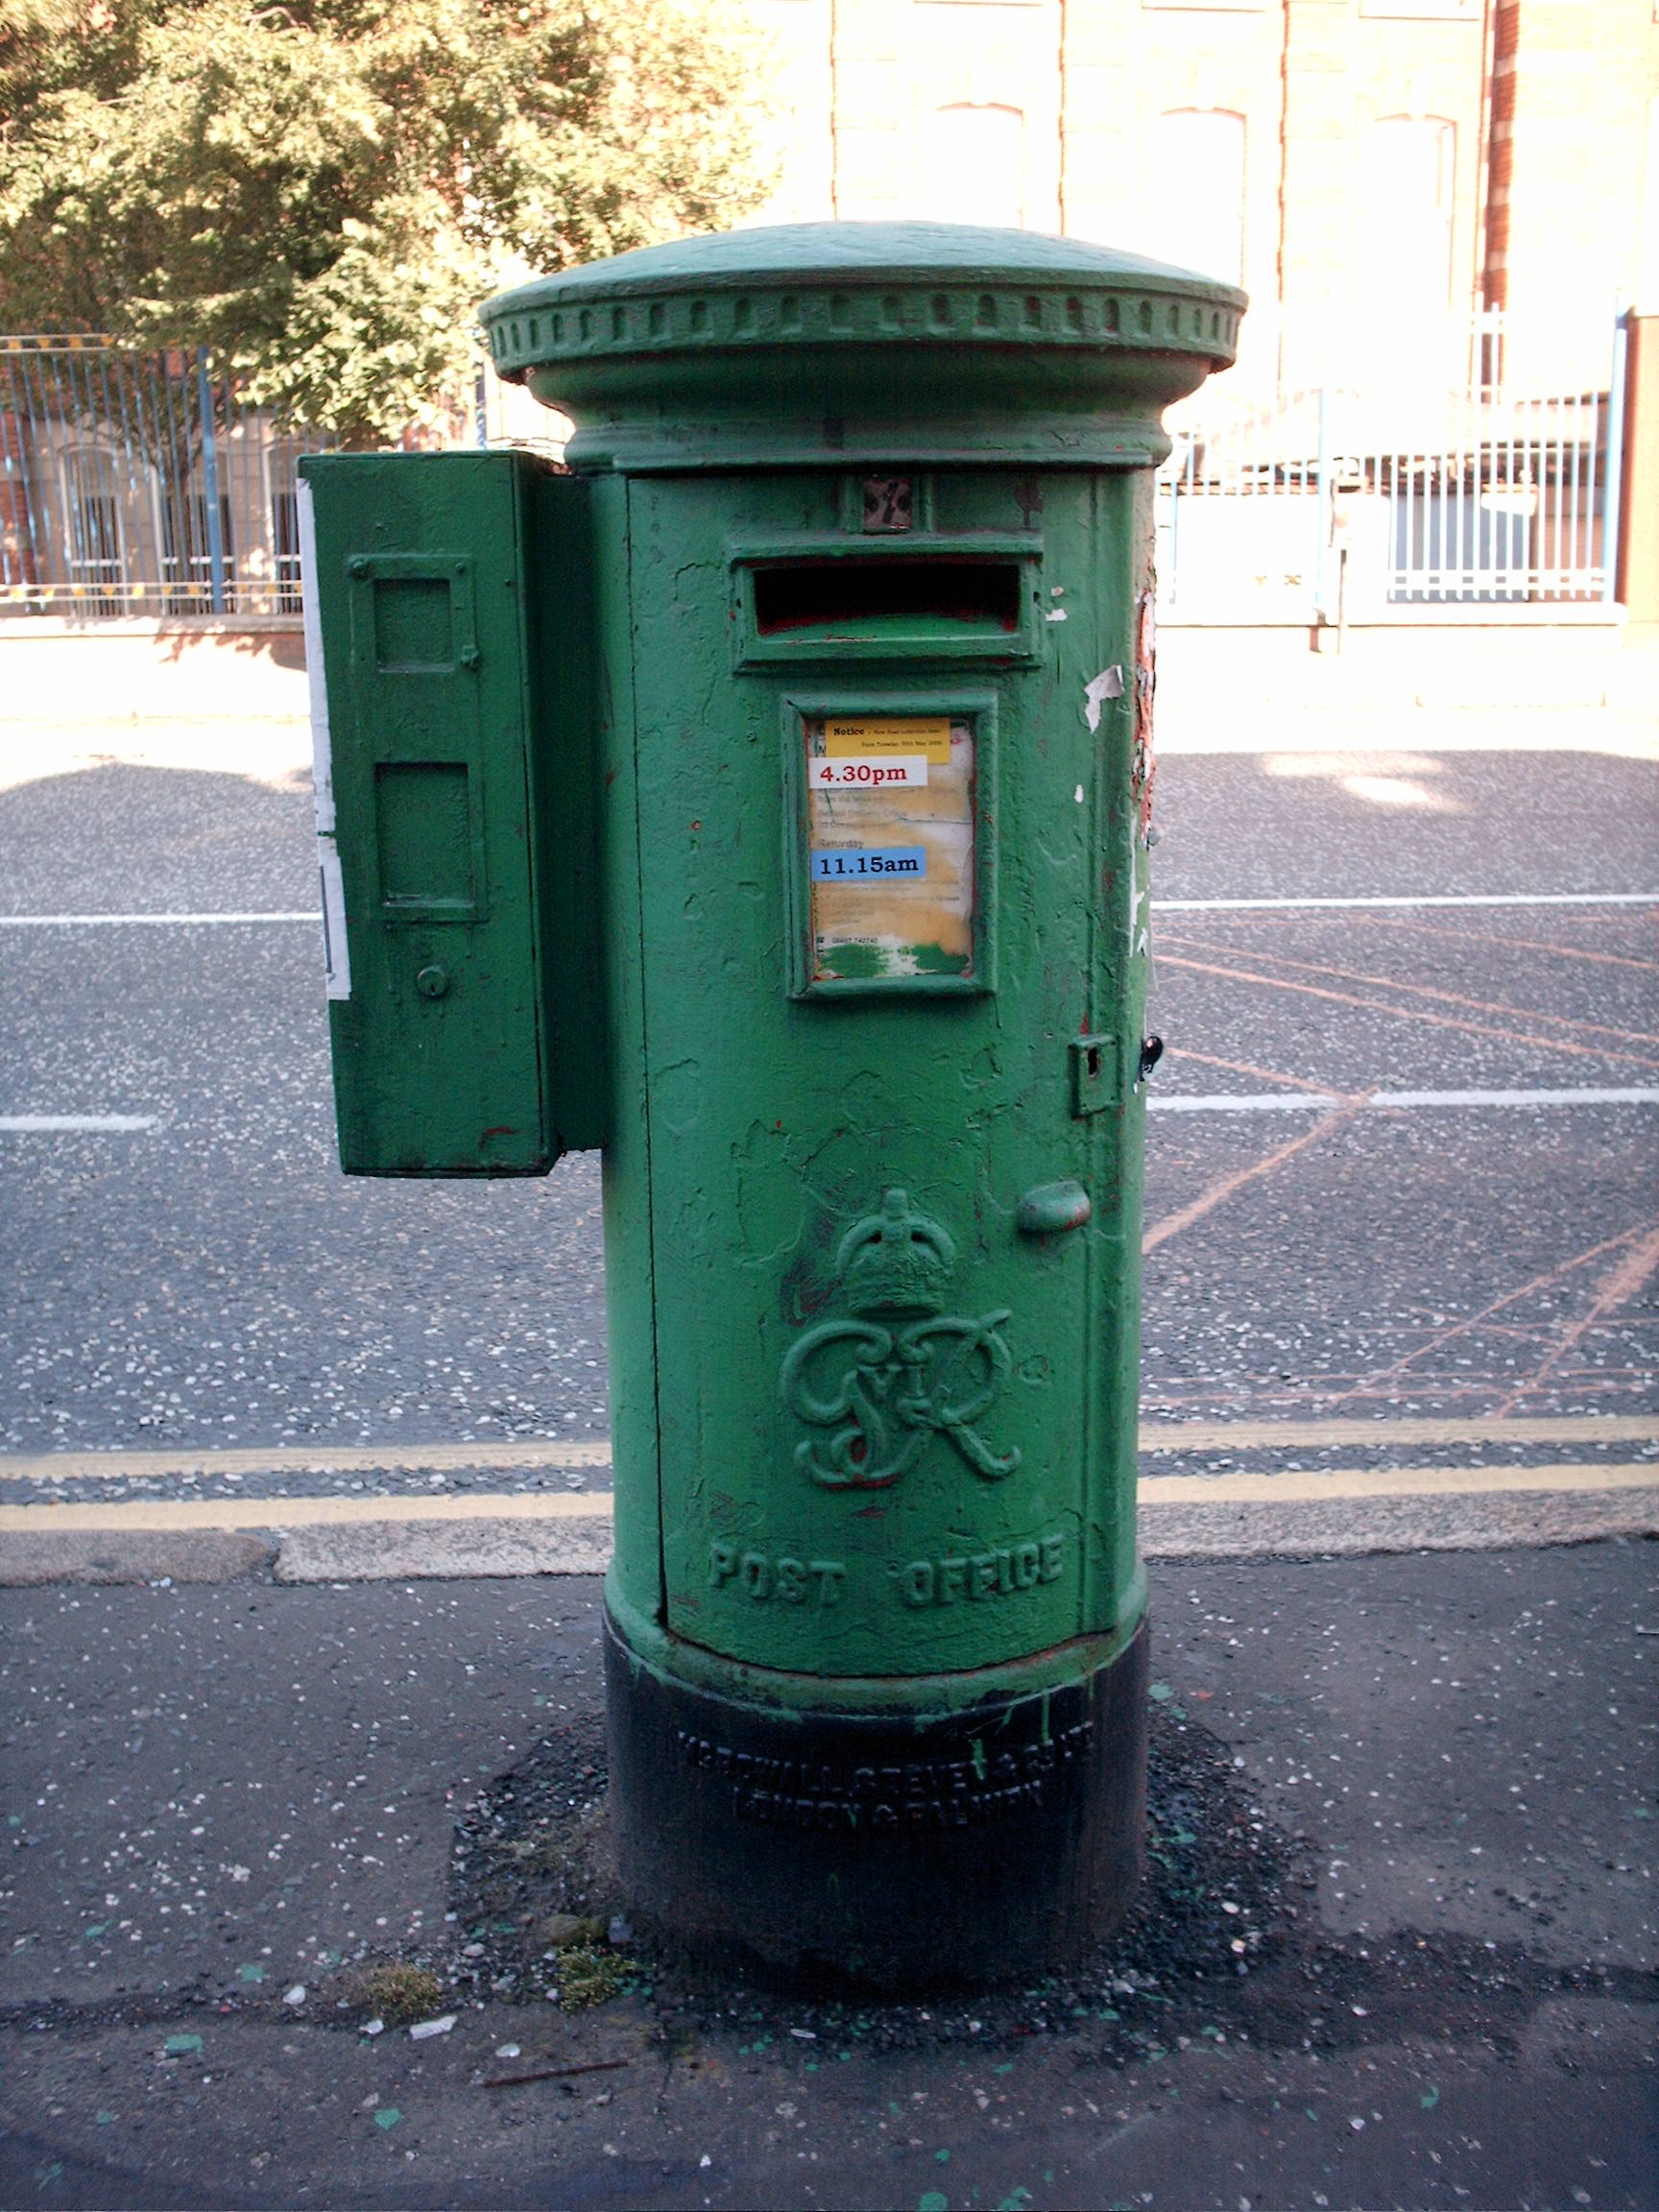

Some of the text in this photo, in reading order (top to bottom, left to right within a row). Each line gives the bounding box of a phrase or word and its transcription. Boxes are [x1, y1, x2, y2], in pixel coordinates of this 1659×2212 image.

[832, 727, 865, 735] Notice
[819, 764, 907, 785] 4.30pm
[820, 856, 919, 876] 11.15am
[709, 1534, 1064, 1608] POST OFFICE
